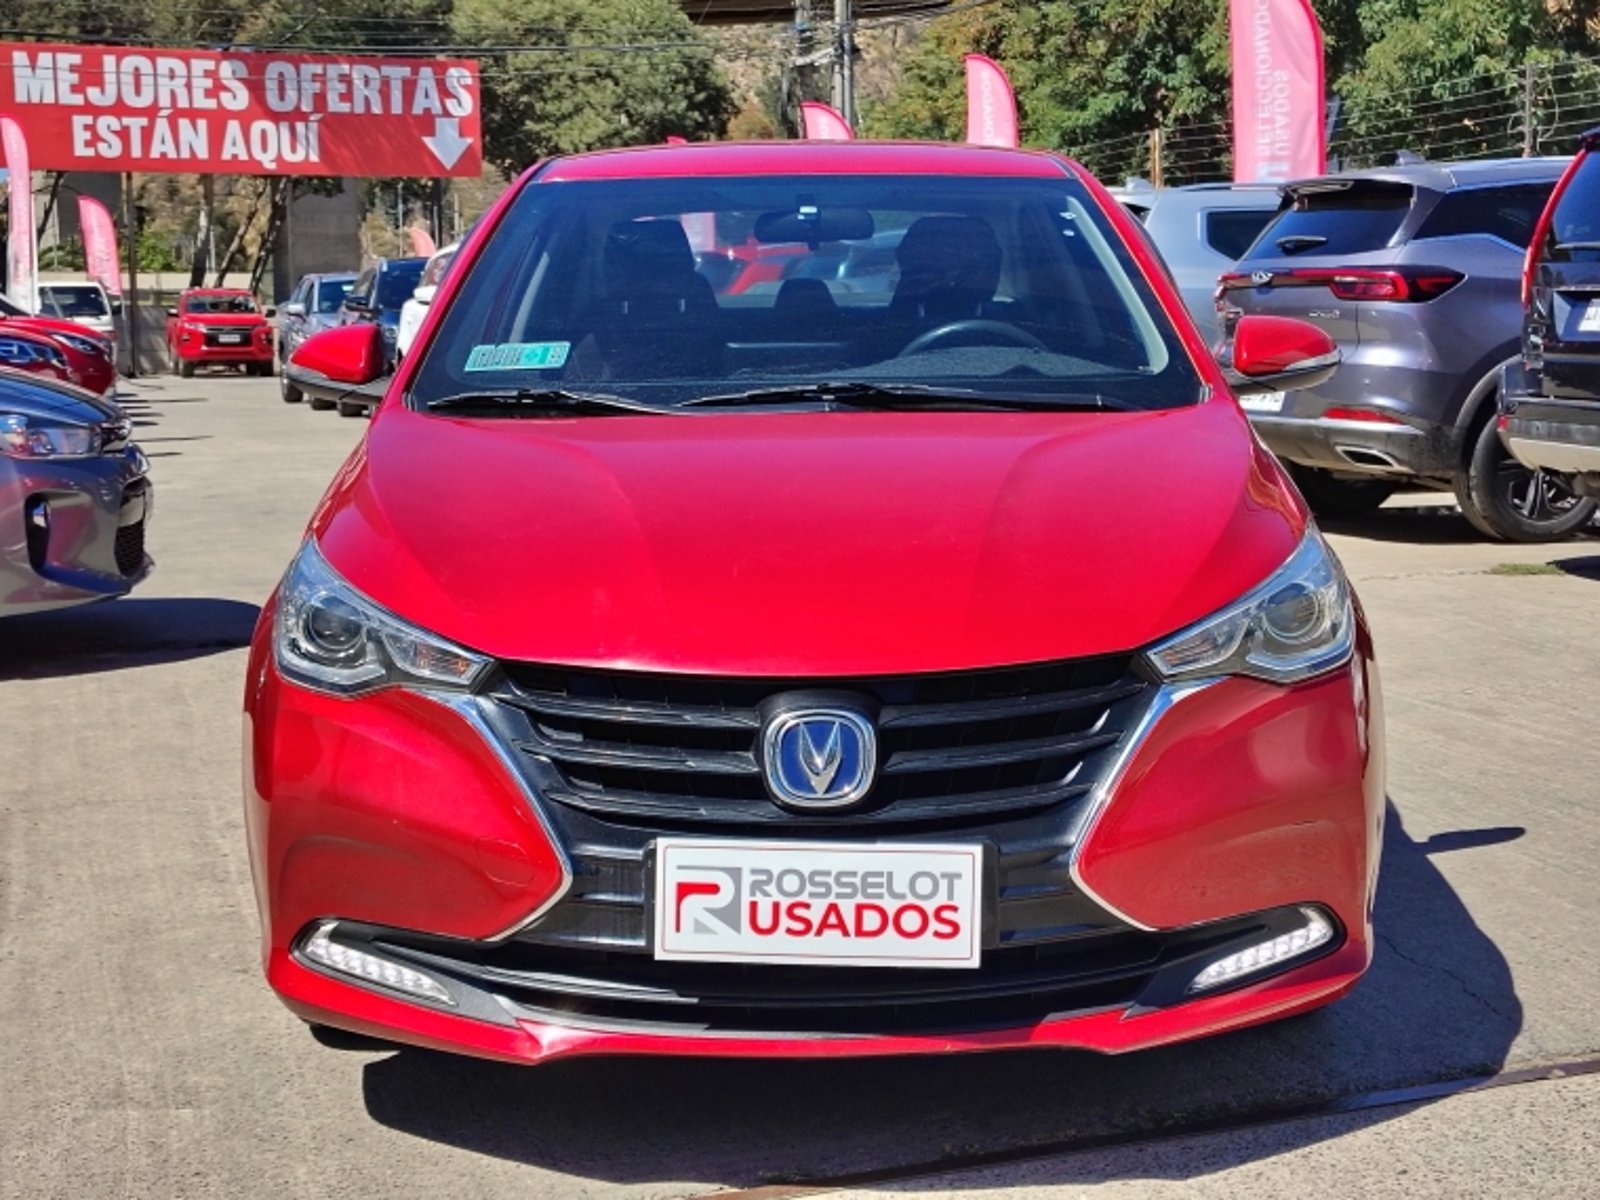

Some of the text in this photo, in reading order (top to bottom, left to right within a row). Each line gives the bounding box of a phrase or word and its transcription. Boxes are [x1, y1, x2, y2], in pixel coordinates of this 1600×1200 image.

[12, 50, 474, 117] MEJORES OFERTAS
[72, 110, 324, 170] ESTÁN AQUÍ
[749, 867, 963, 901] ROSSELOT
[749, 900, 962, 940] USADOS
